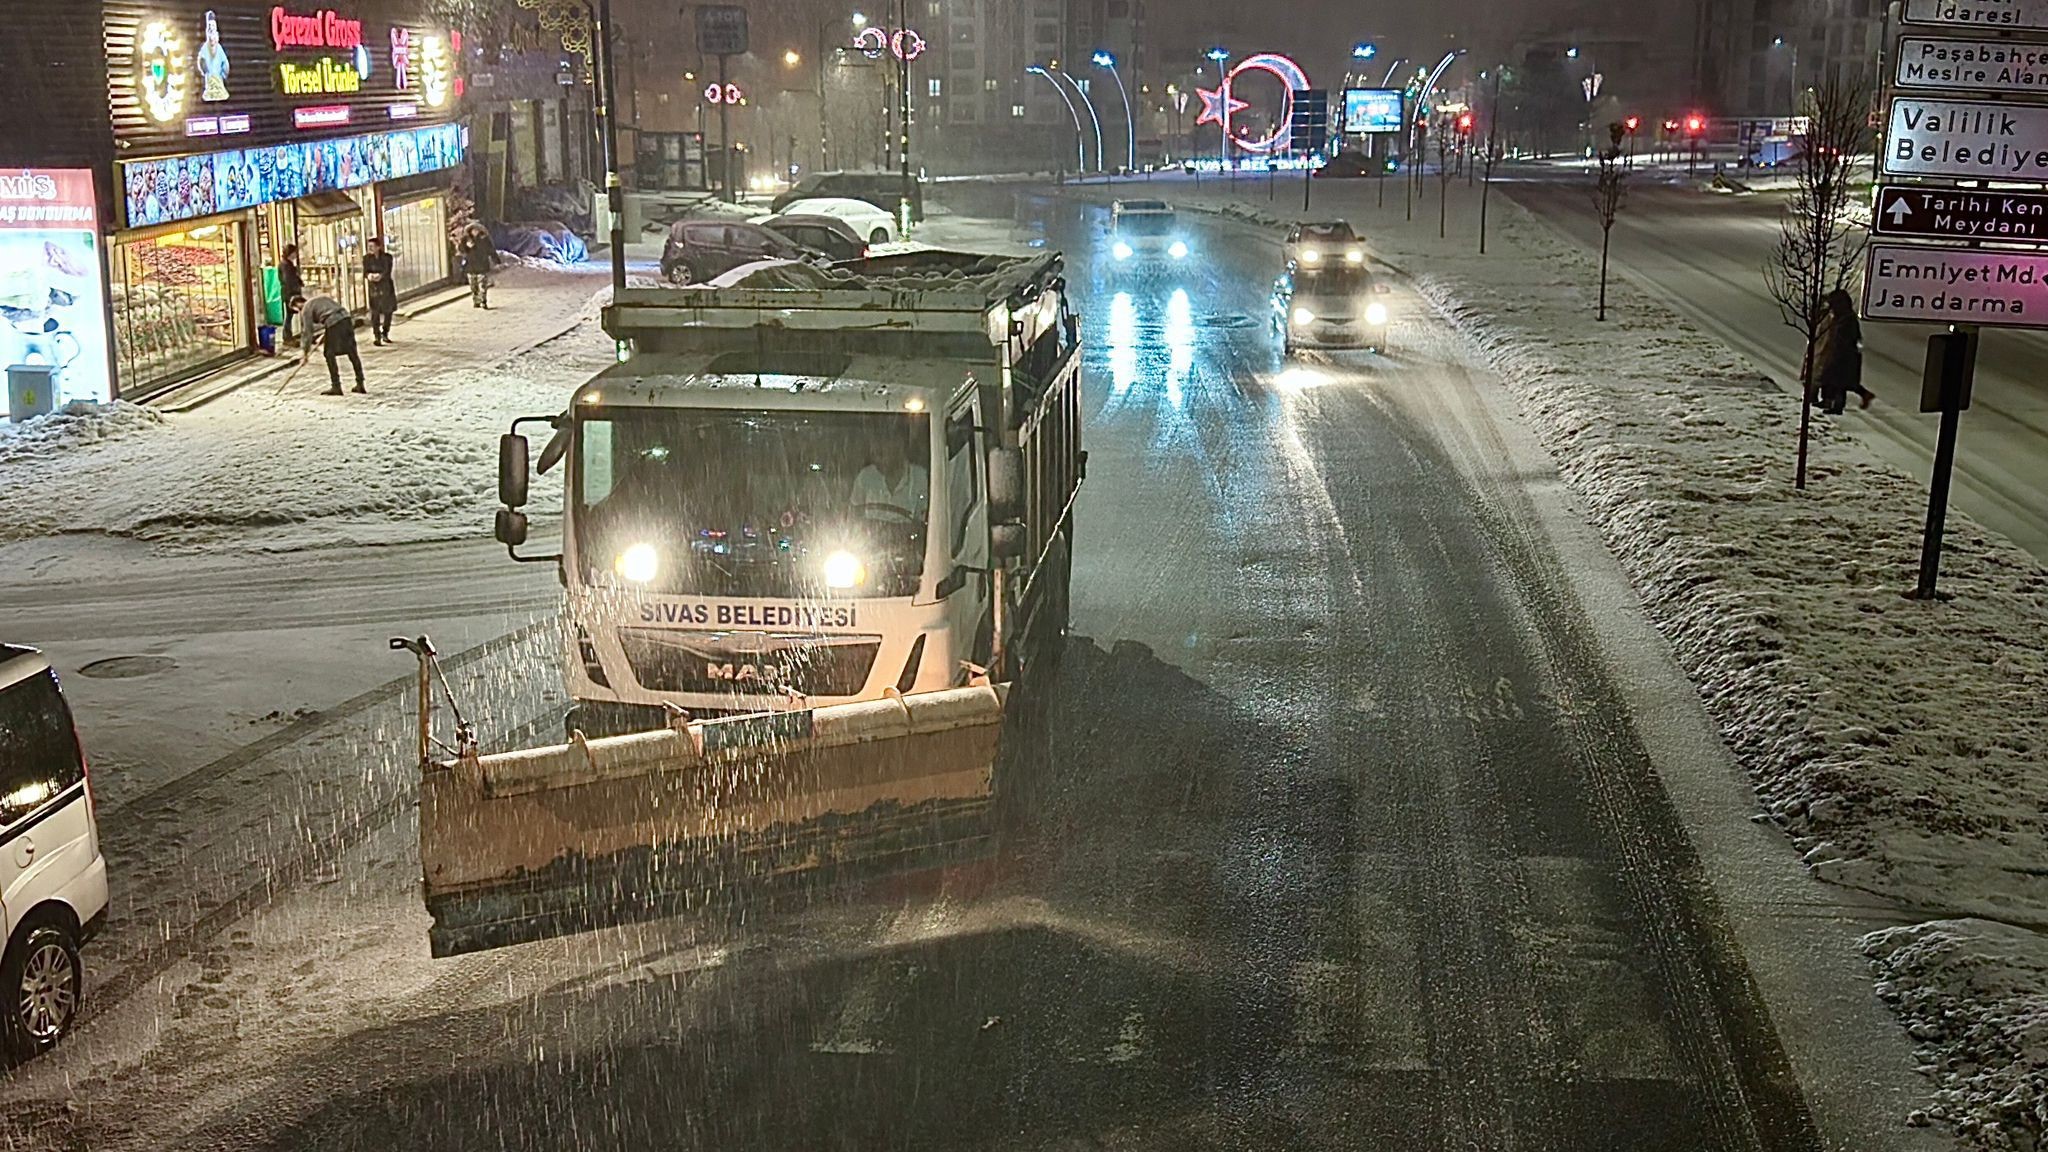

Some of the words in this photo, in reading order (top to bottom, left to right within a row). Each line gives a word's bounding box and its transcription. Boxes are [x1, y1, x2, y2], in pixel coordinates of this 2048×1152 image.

[272, 6, 324, 51] Çerezci
[325, 10, 361, 48] Gross
[1921, 43, 2048, 66] Paşabahçe
[280, 62, 322, 94] Yöresel
[322, 57, 360, 92] Ürünler
[1906, 63, 1986, 82] Mesire
[1903, 107, 2016, 136] Valilik
[1896, 138, 2048, 172] Belediye
[1921, 194, 1990, 213] Tarihi
[1934, 214, 2035, 235] Meydanı
[1878, 258, 1990, 285] Emniyet
[1996, 264, 2038, 284] Md.
[1875, 289, 2024, 313] Jandarma
